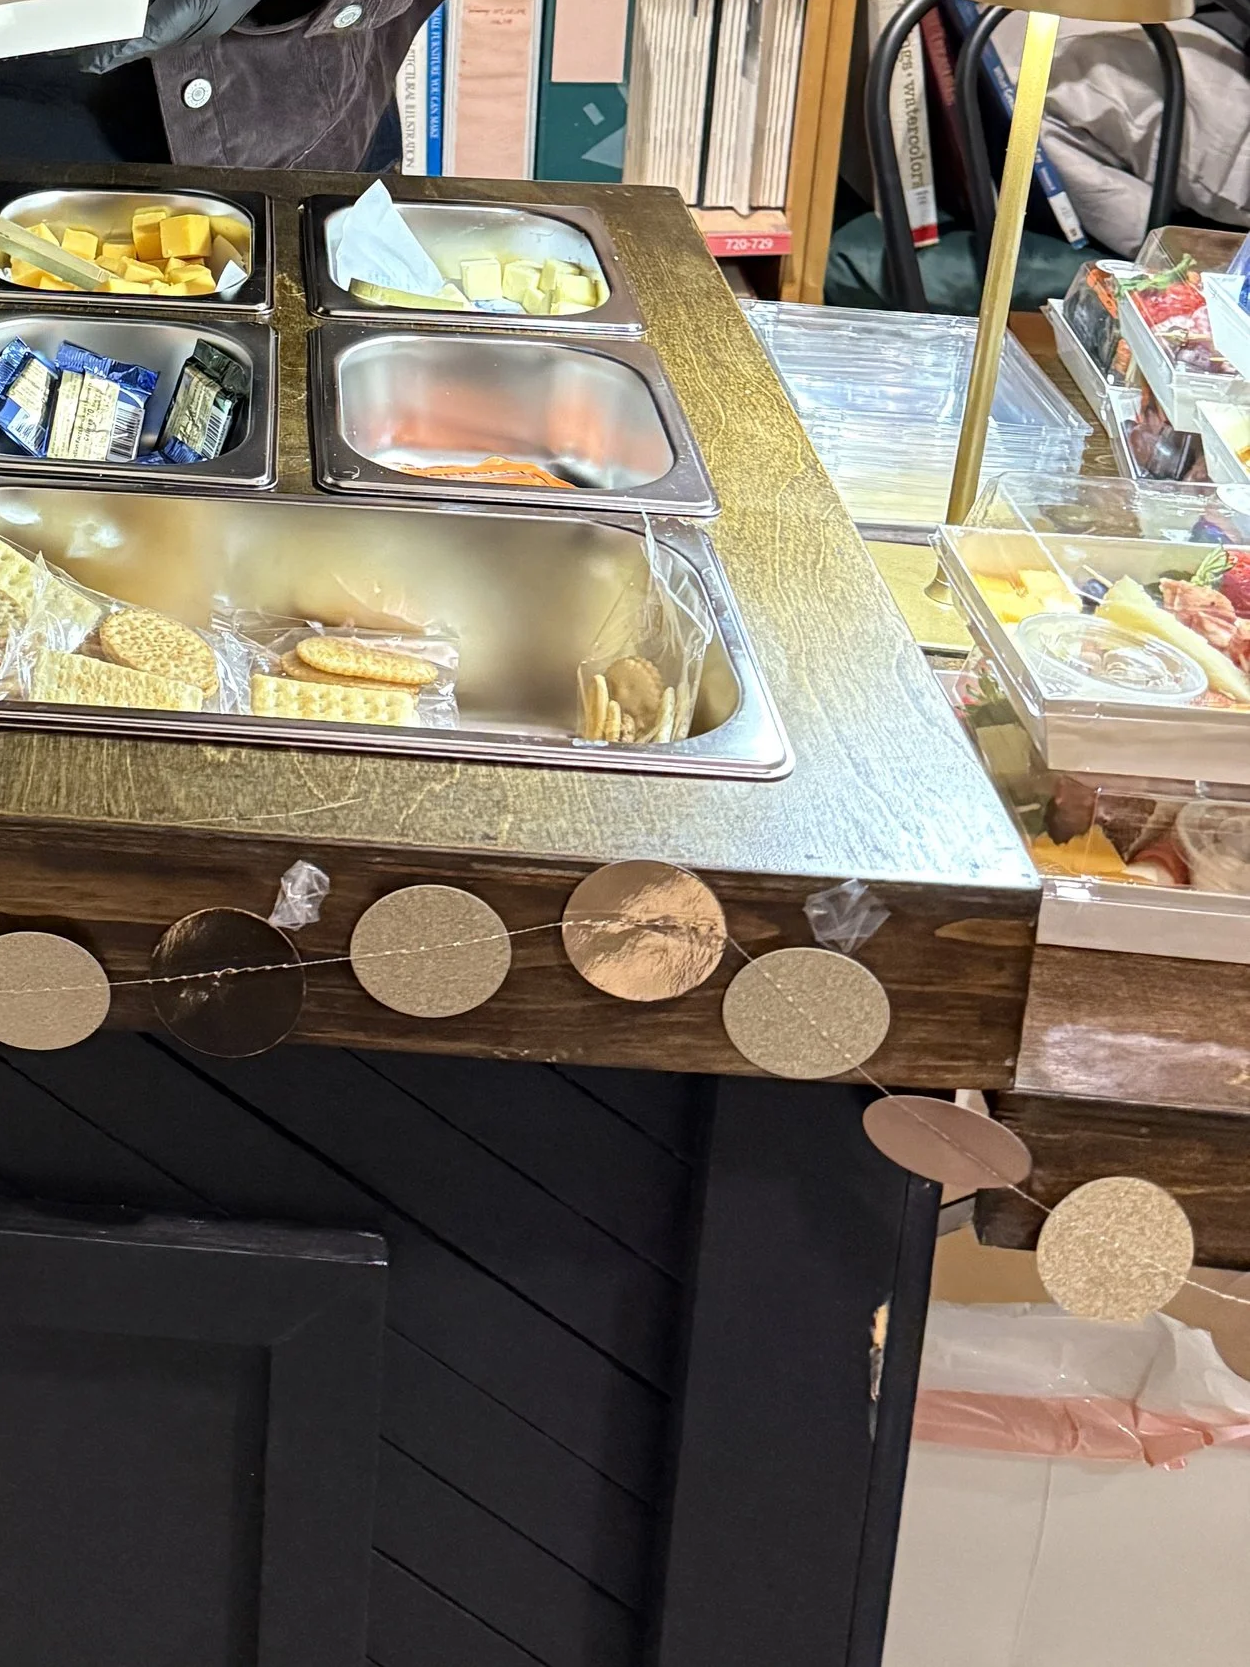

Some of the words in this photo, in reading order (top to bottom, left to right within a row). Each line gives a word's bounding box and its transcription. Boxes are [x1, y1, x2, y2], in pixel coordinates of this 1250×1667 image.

[430, 28, 444, 75] FURNITURE
[430, 77, 442, 94] YOU
[430, 96, 442, 113] CAN
[403, 101, 416, 169] ILLUSTRATION
[429, 114, 442, 139] MAKE
[724, 236, 773, 251] 720-729
